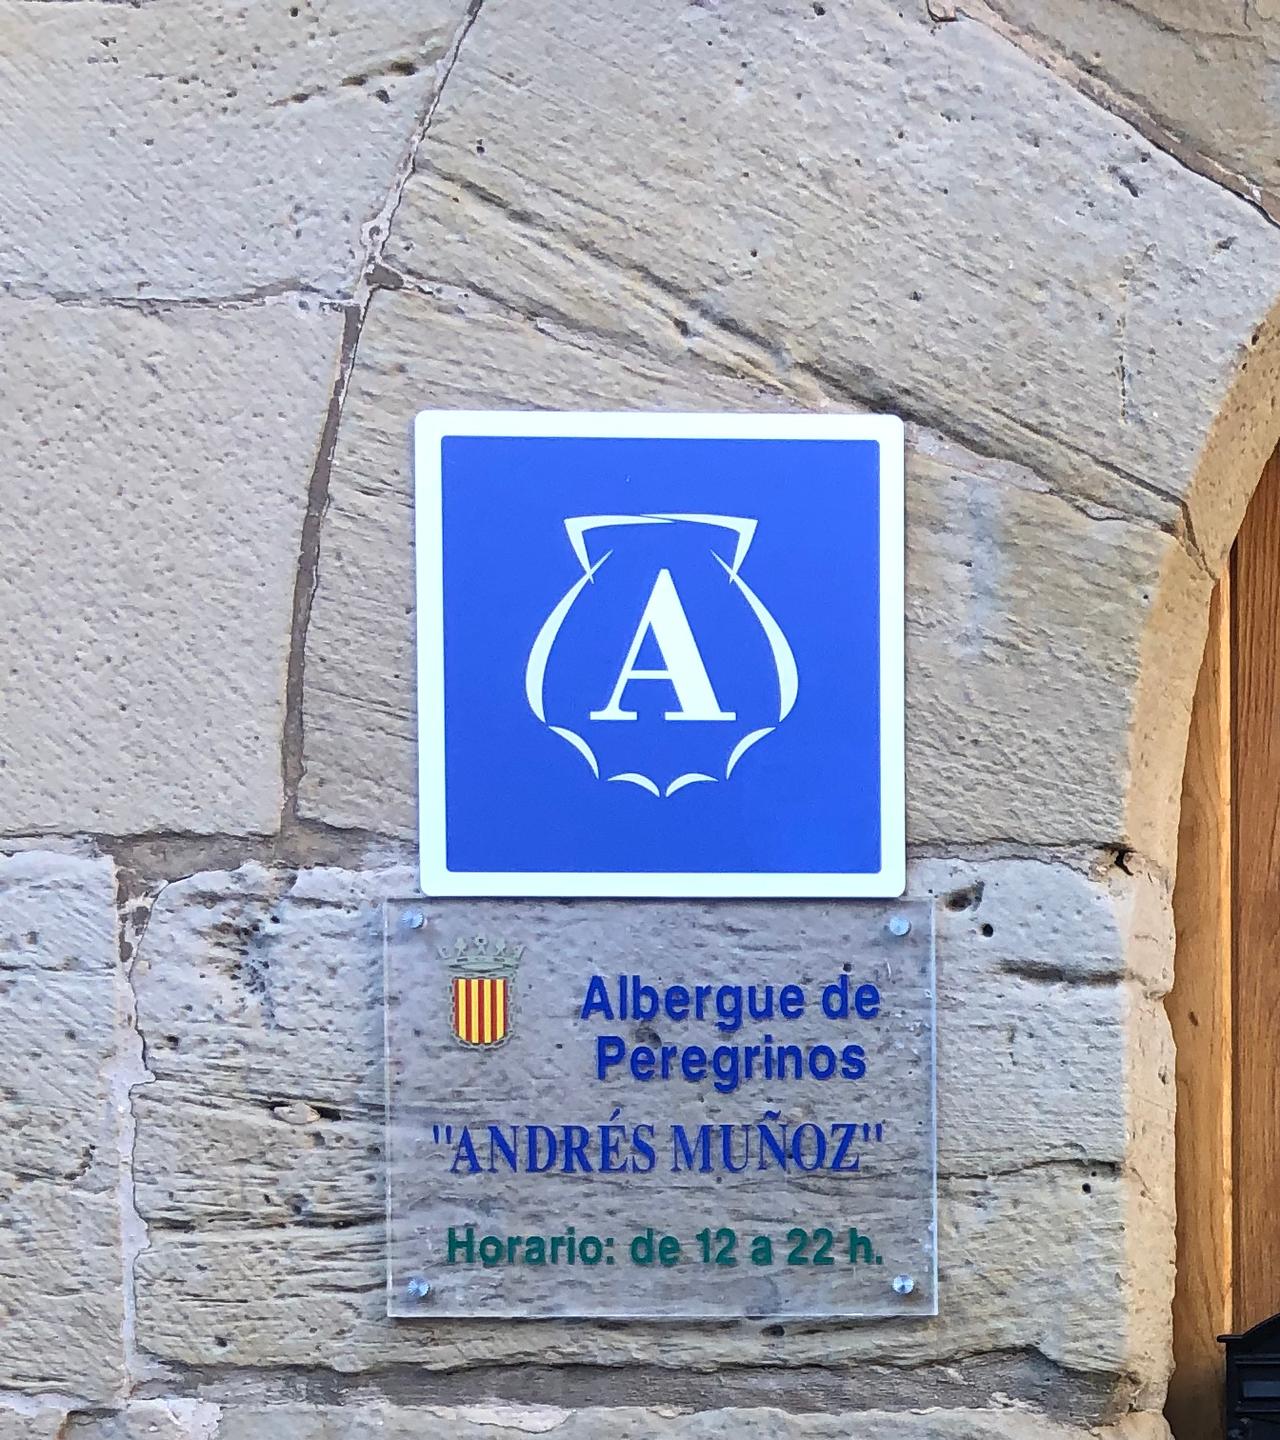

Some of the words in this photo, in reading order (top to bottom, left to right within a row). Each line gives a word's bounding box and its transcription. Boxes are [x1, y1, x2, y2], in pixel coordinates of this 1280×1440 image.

[590, 568, 736, 721] A
[580, 975, 805, 1032] Albergue
[821, 974, 881, 1020] de
[596, 1035, 867, 1093] Peregrinos
[432, 1108, 656, 1174] "ANDRÉS
[670, 1111, 882, 1173] MUÑOZ"
[447, 1226, 615, 1265] Horario:
[630, 1228, 680, 1266] de
[698, 1228, 737, 1265] 12
[750, 1236, 773, 1266] a
[787, 1229, 834, 1265] 22
[848, 1229, 883, 1266] h.
